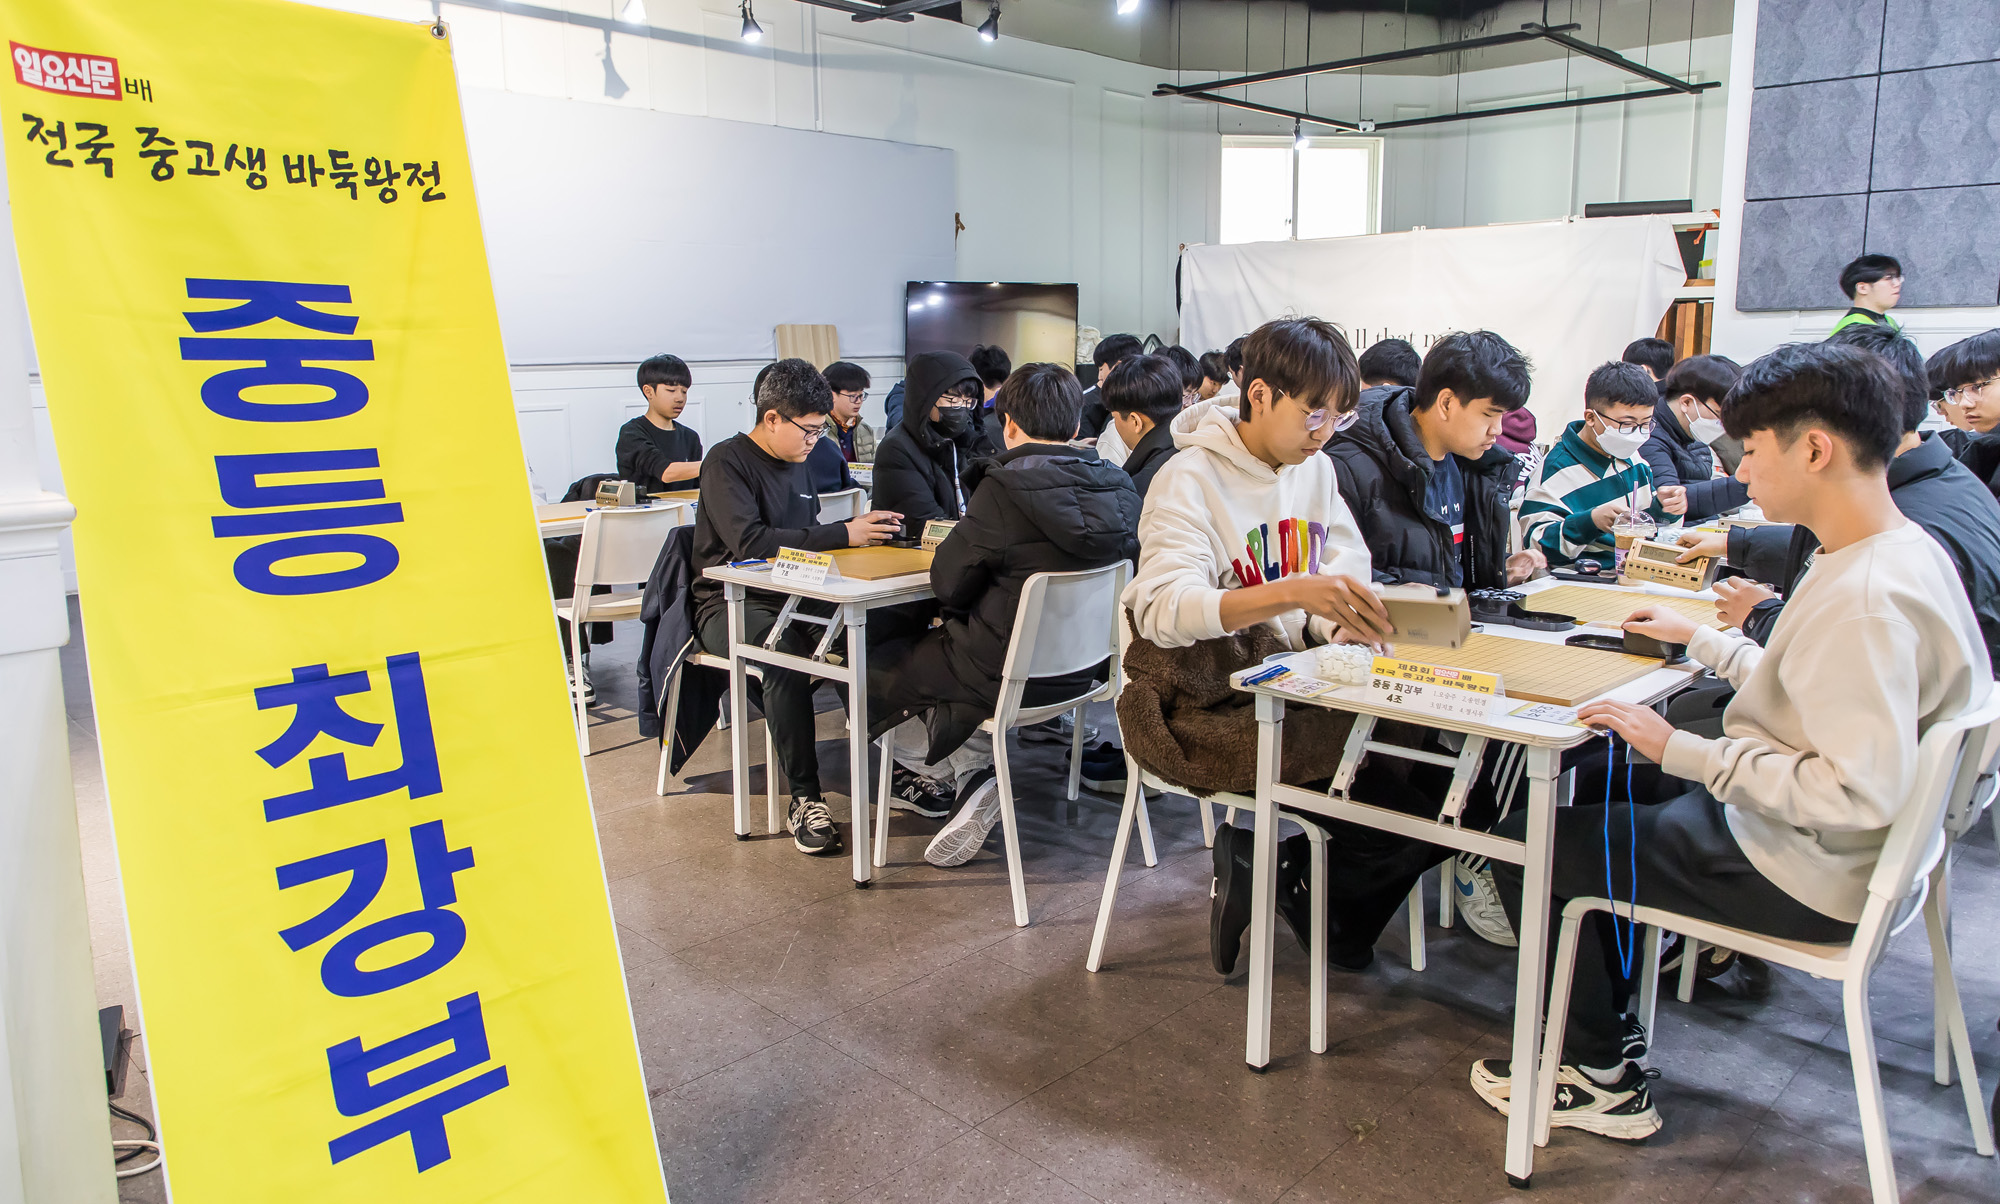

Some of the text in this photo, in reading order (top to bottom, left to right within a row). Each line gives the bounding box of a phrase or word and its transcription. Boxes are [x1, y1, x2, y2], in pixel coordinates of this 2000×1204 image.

[15, 47, 153, 103] 일요신문 배
[22, 113, 446, 204] 전국 중고생 바둑왕전
[1375, 667, 1490, 693] 전국 중고생 바둑왕전
[1397, 662, 1431, 675] 제8회
[1433, 667, 1459, 680] 일요신문
[1372, 678, 1423, 696] 중등 최강부
[1386, 693, 1403, 704] 4조
[179, 278, 510, 1174] 중등 최강부
